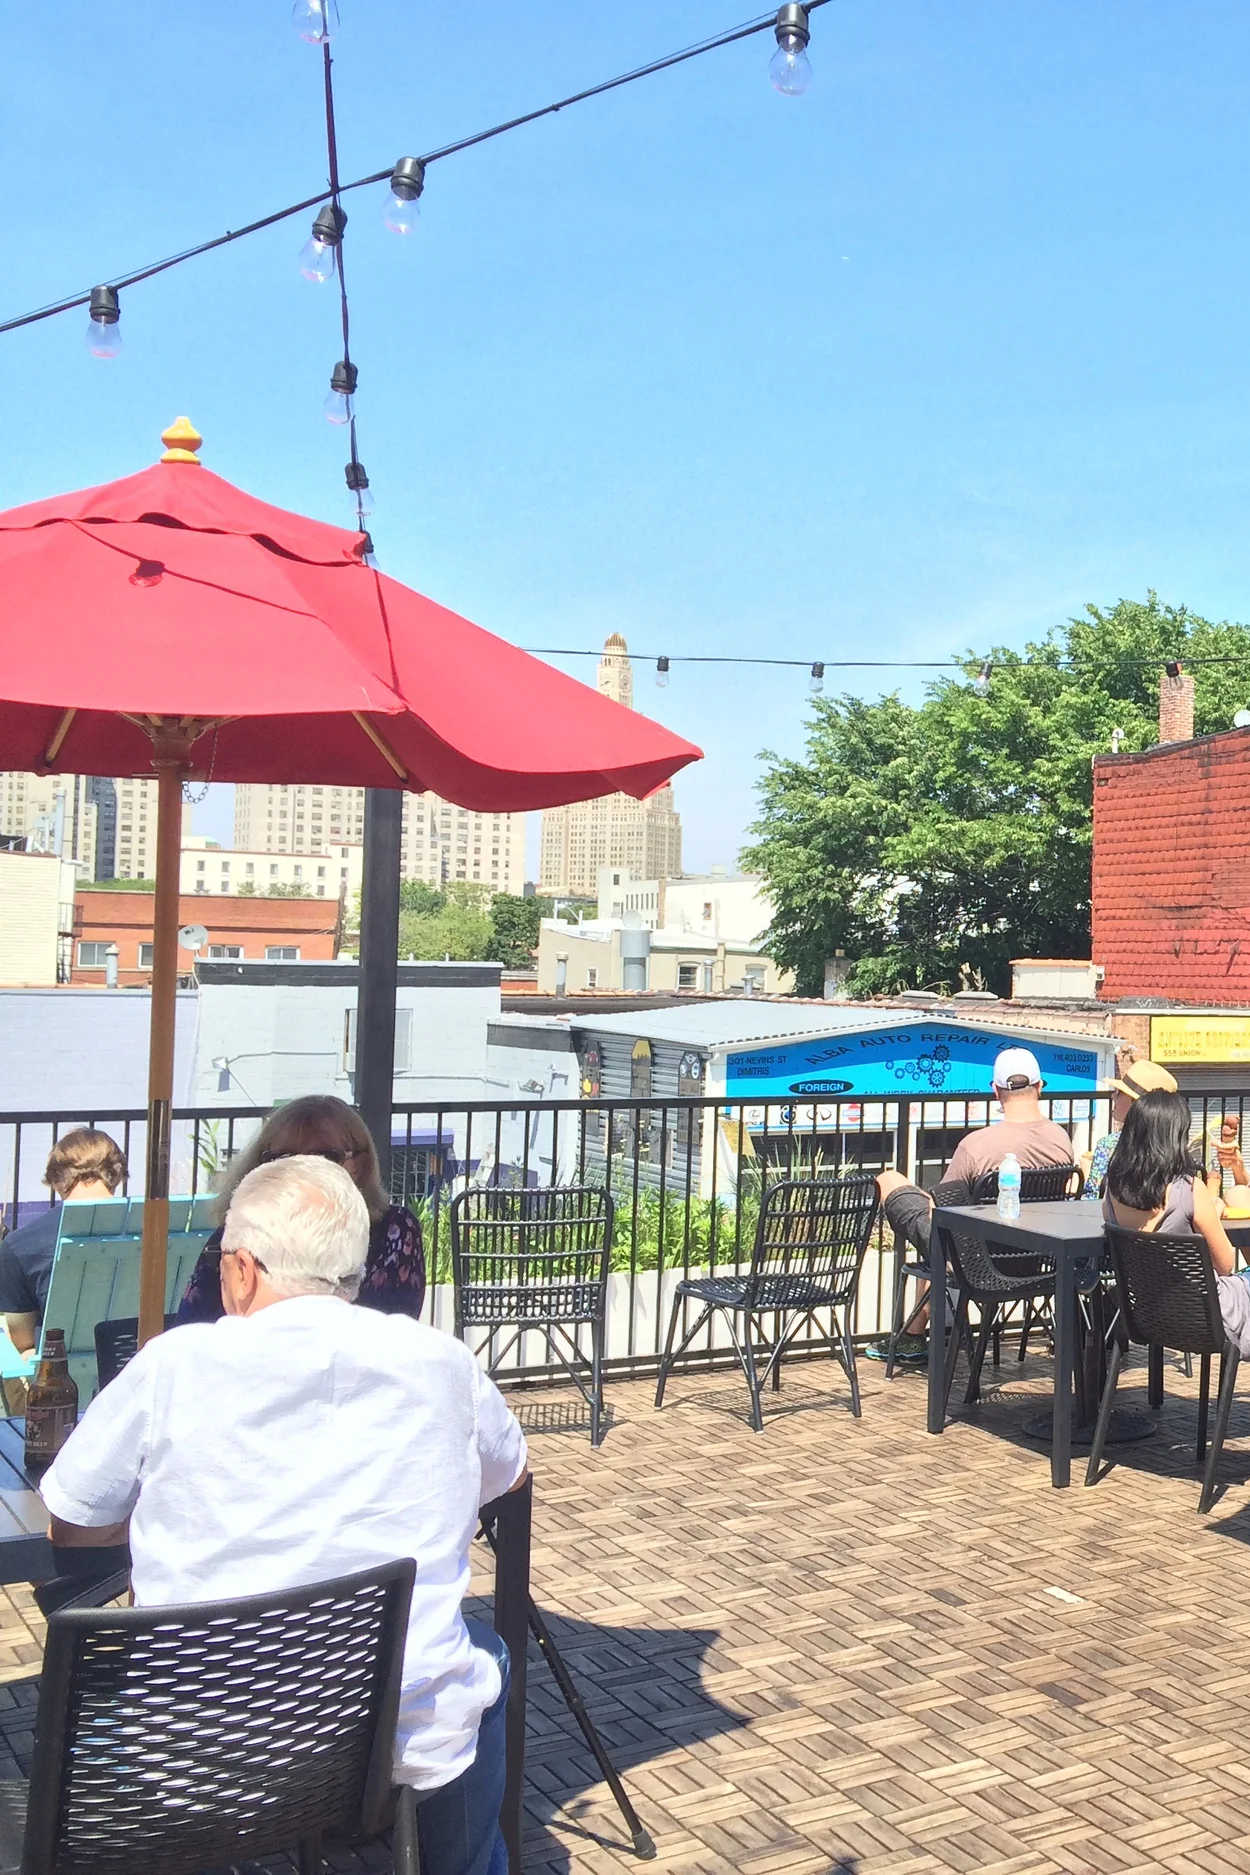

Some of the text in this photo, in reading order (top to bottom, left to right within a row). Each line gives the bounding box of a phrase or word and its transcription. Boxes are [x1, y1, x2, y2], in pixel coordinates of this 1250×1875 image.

[804, 1045, 854, 1066] ALBA
[860, 1034, 912, 1048] AUTO
[921, 1033, 989, 1046] REPAIR
[729, 1055, 788, 1065] 301 NEVINS ST
[737, 1067, 770, 1076] DIMITRIS
[1066, 1064, 1091, 1073] CARLOS
[798, 1083, 845, 1092] FOREIGN
